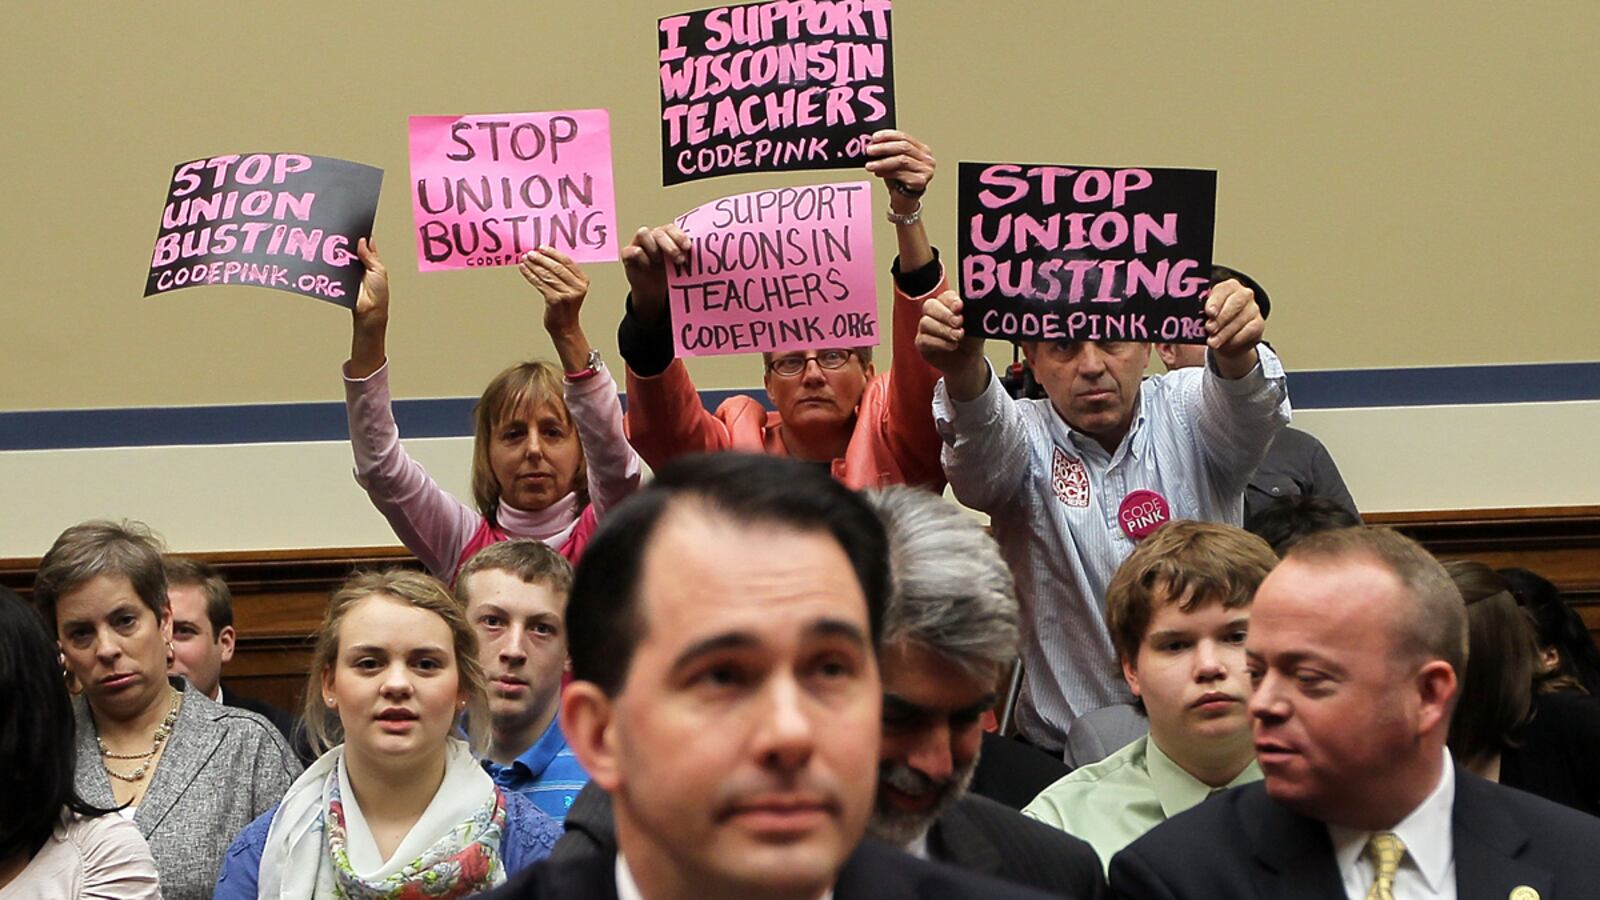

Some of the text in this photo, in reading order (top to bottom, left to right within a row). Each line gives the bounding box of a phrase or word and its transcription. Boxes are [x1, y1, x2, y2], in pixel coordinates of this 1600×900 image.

[659, 0, 892, 62] I SUPPORT
[659, 40, 885, 101] WISCONSIN
[662, 85, 887, 147] TEACHERS
[446, 116, 578, 164] STOP
[676, 133, 873, 175] CODEPINK.OR
[173, 153, 312, 197] STOP
[417, 172, 593, 215] UNION
[978, 164, 1153, 209] STOP
[162, 190, 315, 229] UNION
[712, 185, 863, 229] SUPPORT
[152, 222, 360, 268] BUSTING
[419, 210, 607, 263] BUSTING
[970, 211, 1179, 254] UNION
[156, 261, 346, 297] CODEPINK.ORG
[466, 254, 519, 266] CODEPI
[962, 254, 1210, 303] BUSTING
[671, 268, 850, 314] TEACHERS
[681, 312, 876, 351] CODEPINK.ORG
[982, 309, 1205, 340] CODEPINK.ORG
[1121, 497, 1163, 522] CODE
[1126, 509, 1165, 533] PINK
